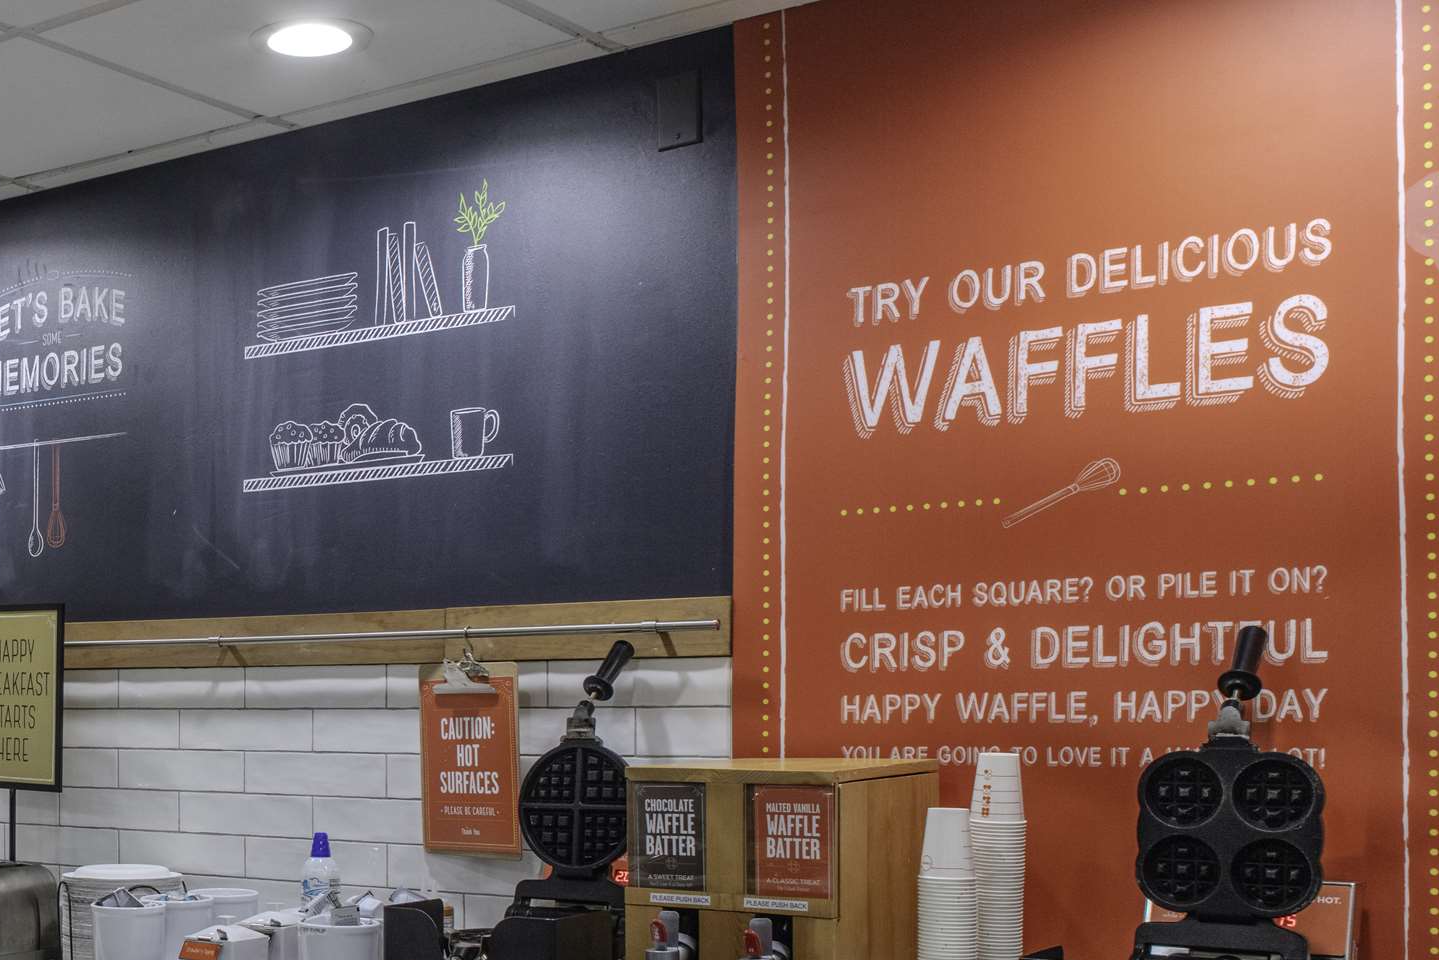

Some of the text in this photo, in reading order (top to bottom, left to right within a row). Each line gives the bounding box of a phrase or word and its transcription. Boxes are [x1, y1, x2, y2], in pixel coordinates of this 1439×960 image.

[846, 218, 1333, 327] TRY OUR DELICIOUS
[58, 286, 126, 327] BAKE
[42, 331, 63, 346] SOME
[842, 294, 1331, 440] WAFFLES
[840, 564, 1328, 613] FILL EACH SQUARE? OR PILE IT ON?
[840, 617, 1329, 673] CRISP & DELIGHTUL
[840, 692, 942, 724] HAPPY
[955, 690, 1098, 727] WAFFLE,
[1252, 688, 1328, 722] DAY
[440, 716, 495, 741] CAUTION:
[456, 744, 480, 767] HOT
[1047, 746, 1101, 767] LOVE
[1110, 747, 1130, 767] IT
[1139, 747, 1153, 765] A
[440, 771, 500, 795] SURFACES
[444, 805, 464, 816] PLEASE
[472, 806, 496, 817] CAREFUL
[644, 799, 695, 813] CHOCOLATE
[765, 802, 821, 814] MALTED VANILLA
[645, 813, 696, 836] WAFFLE
[765, 814, 821, 837] WAFFLE
[645, 834, 696, 857] BATTER
[765, 837, 821, 860] BATTER
[652, 894, 675, 903] PLEASE
[693, 896, 709, 904] BACK
[746, 899, 807, 910] PLEASE PUSH BACK
[1316, 896, 1342, 905] HOT.
